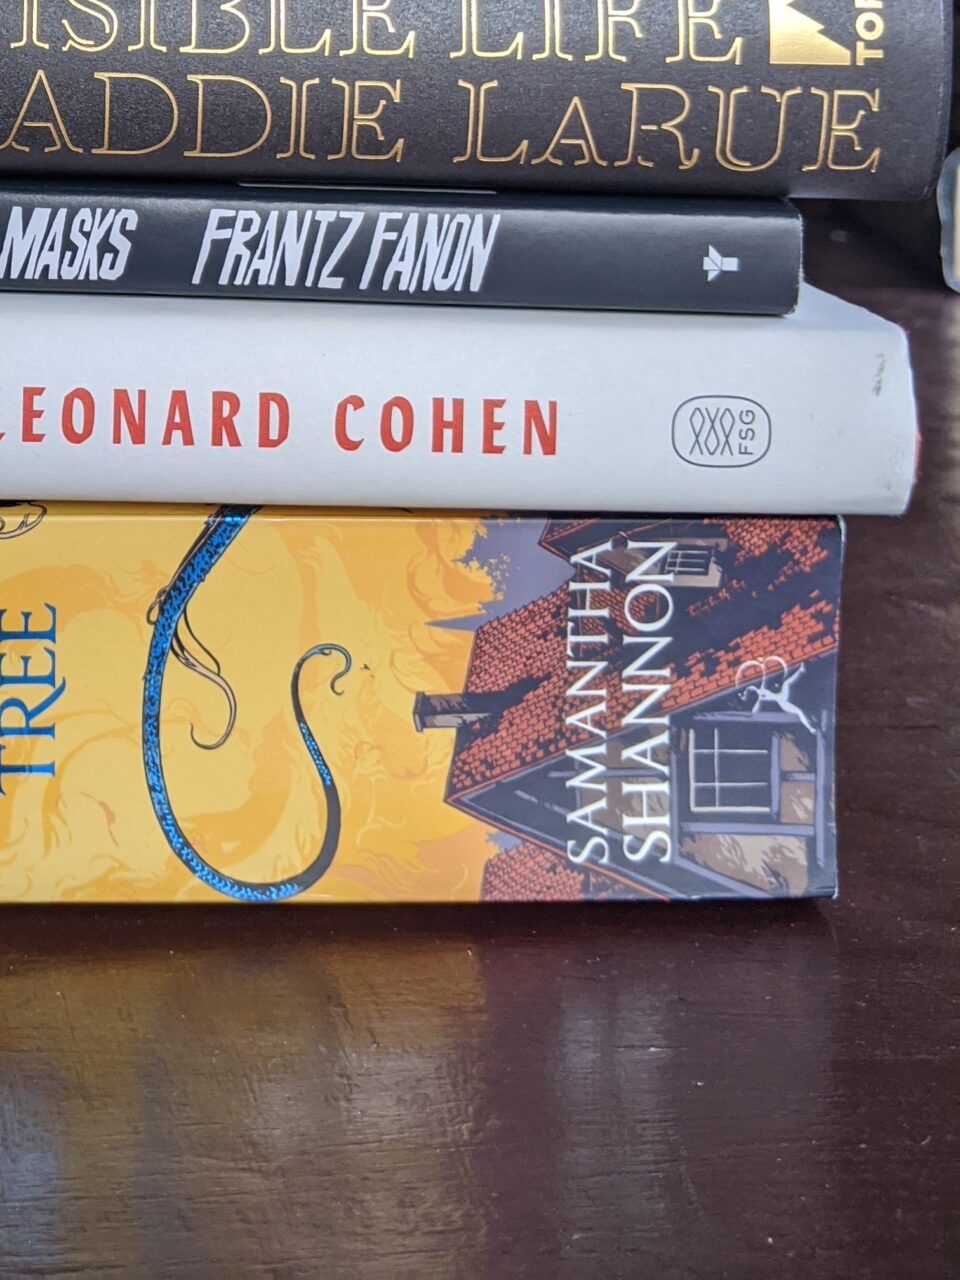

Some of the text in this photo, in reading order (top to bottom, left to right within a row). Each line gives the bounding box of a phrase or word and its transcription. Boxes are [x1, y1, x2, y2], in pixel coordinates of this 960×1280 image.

[451, 78, 882, 174] LARUE
[191, 208, 501, 294] FRANTZ FANON
[334, 393, 558, 457] COHEN
[738, 408, 755, 456] FSG
[565, 536, 615, 865] SAMANTHA
[621, 537, 678, 864] SHANNON
